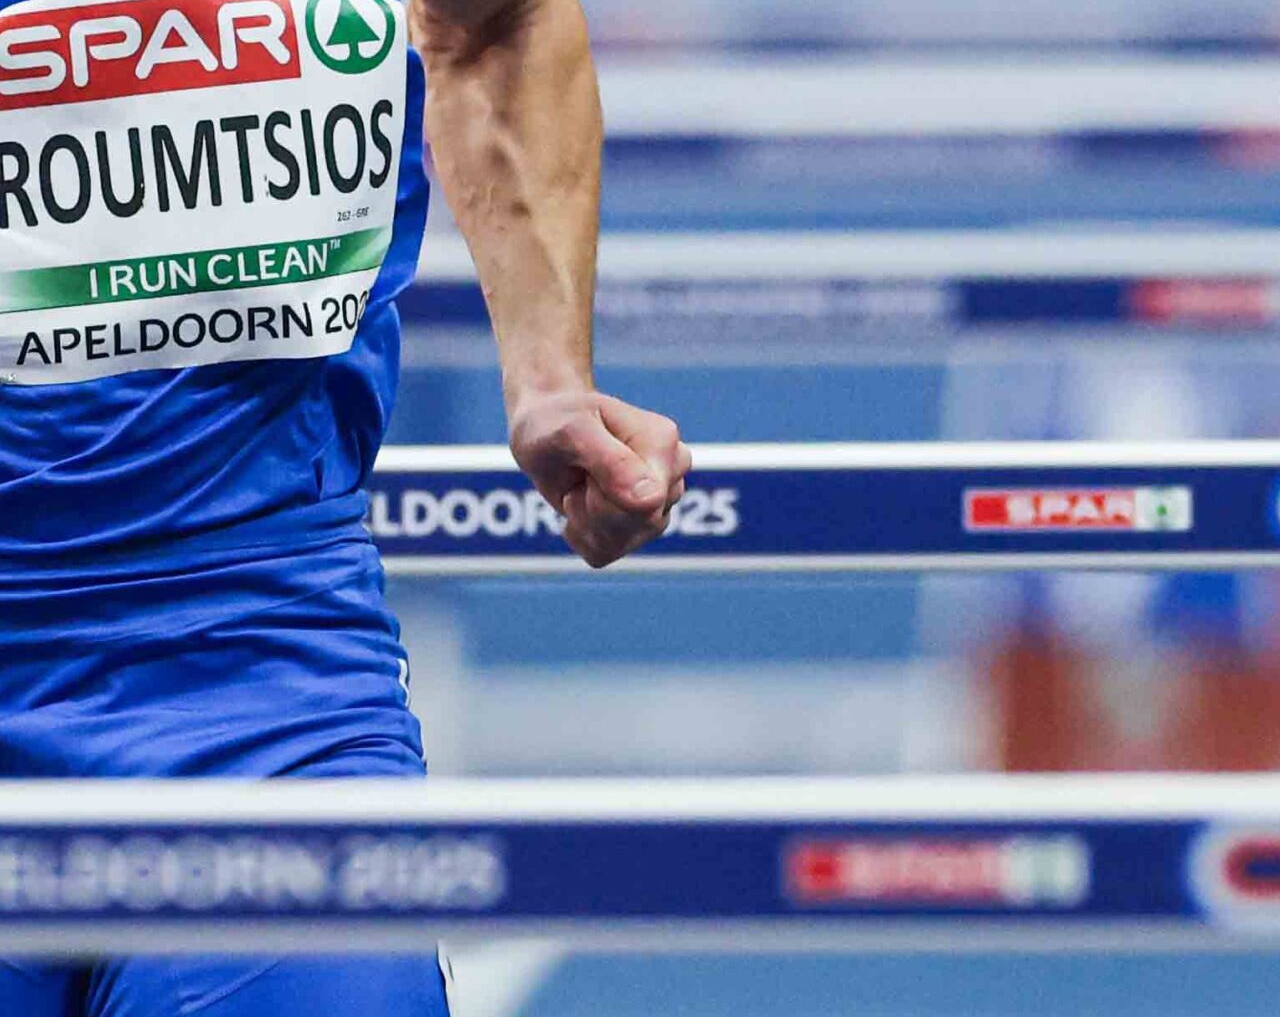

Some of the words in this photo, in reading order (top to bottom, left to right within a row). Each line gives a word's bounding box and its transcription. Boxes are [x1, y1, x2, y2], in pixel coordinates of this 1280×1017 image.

[88, 267, 99, 299] I
[109, 256, 197, 297] RUN
[15, 301, 314, 367] APELDOORN
